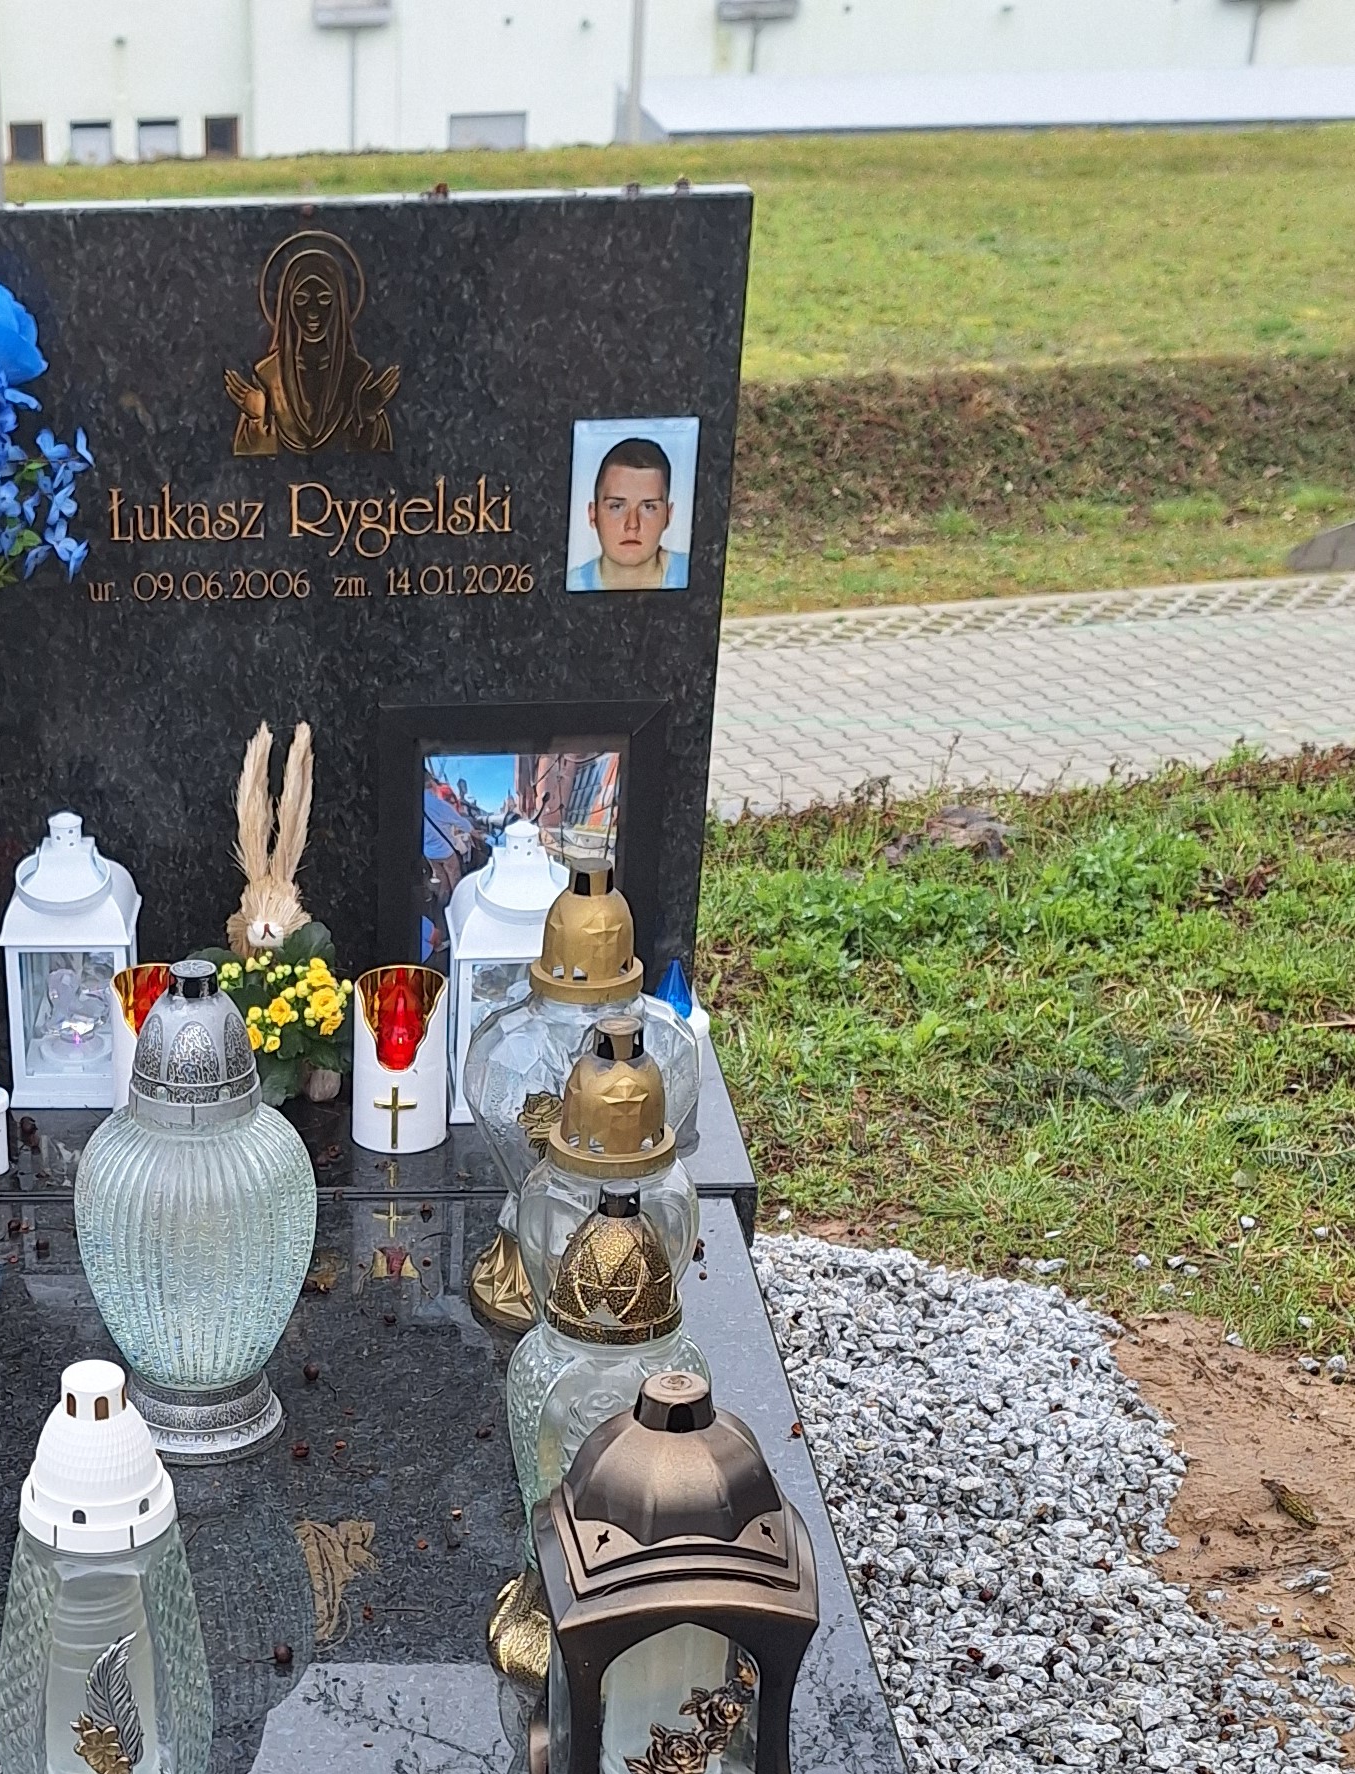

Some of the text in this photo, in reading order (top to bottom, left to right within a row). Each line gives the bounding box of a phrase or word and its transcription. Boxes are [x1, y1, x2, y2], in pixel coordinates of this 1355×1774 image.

[108, 474, 512, 558] Łukasz Rygielski
[88, 563, 535, 603] ur. 09.06.2006 zm. 14.01.2026
